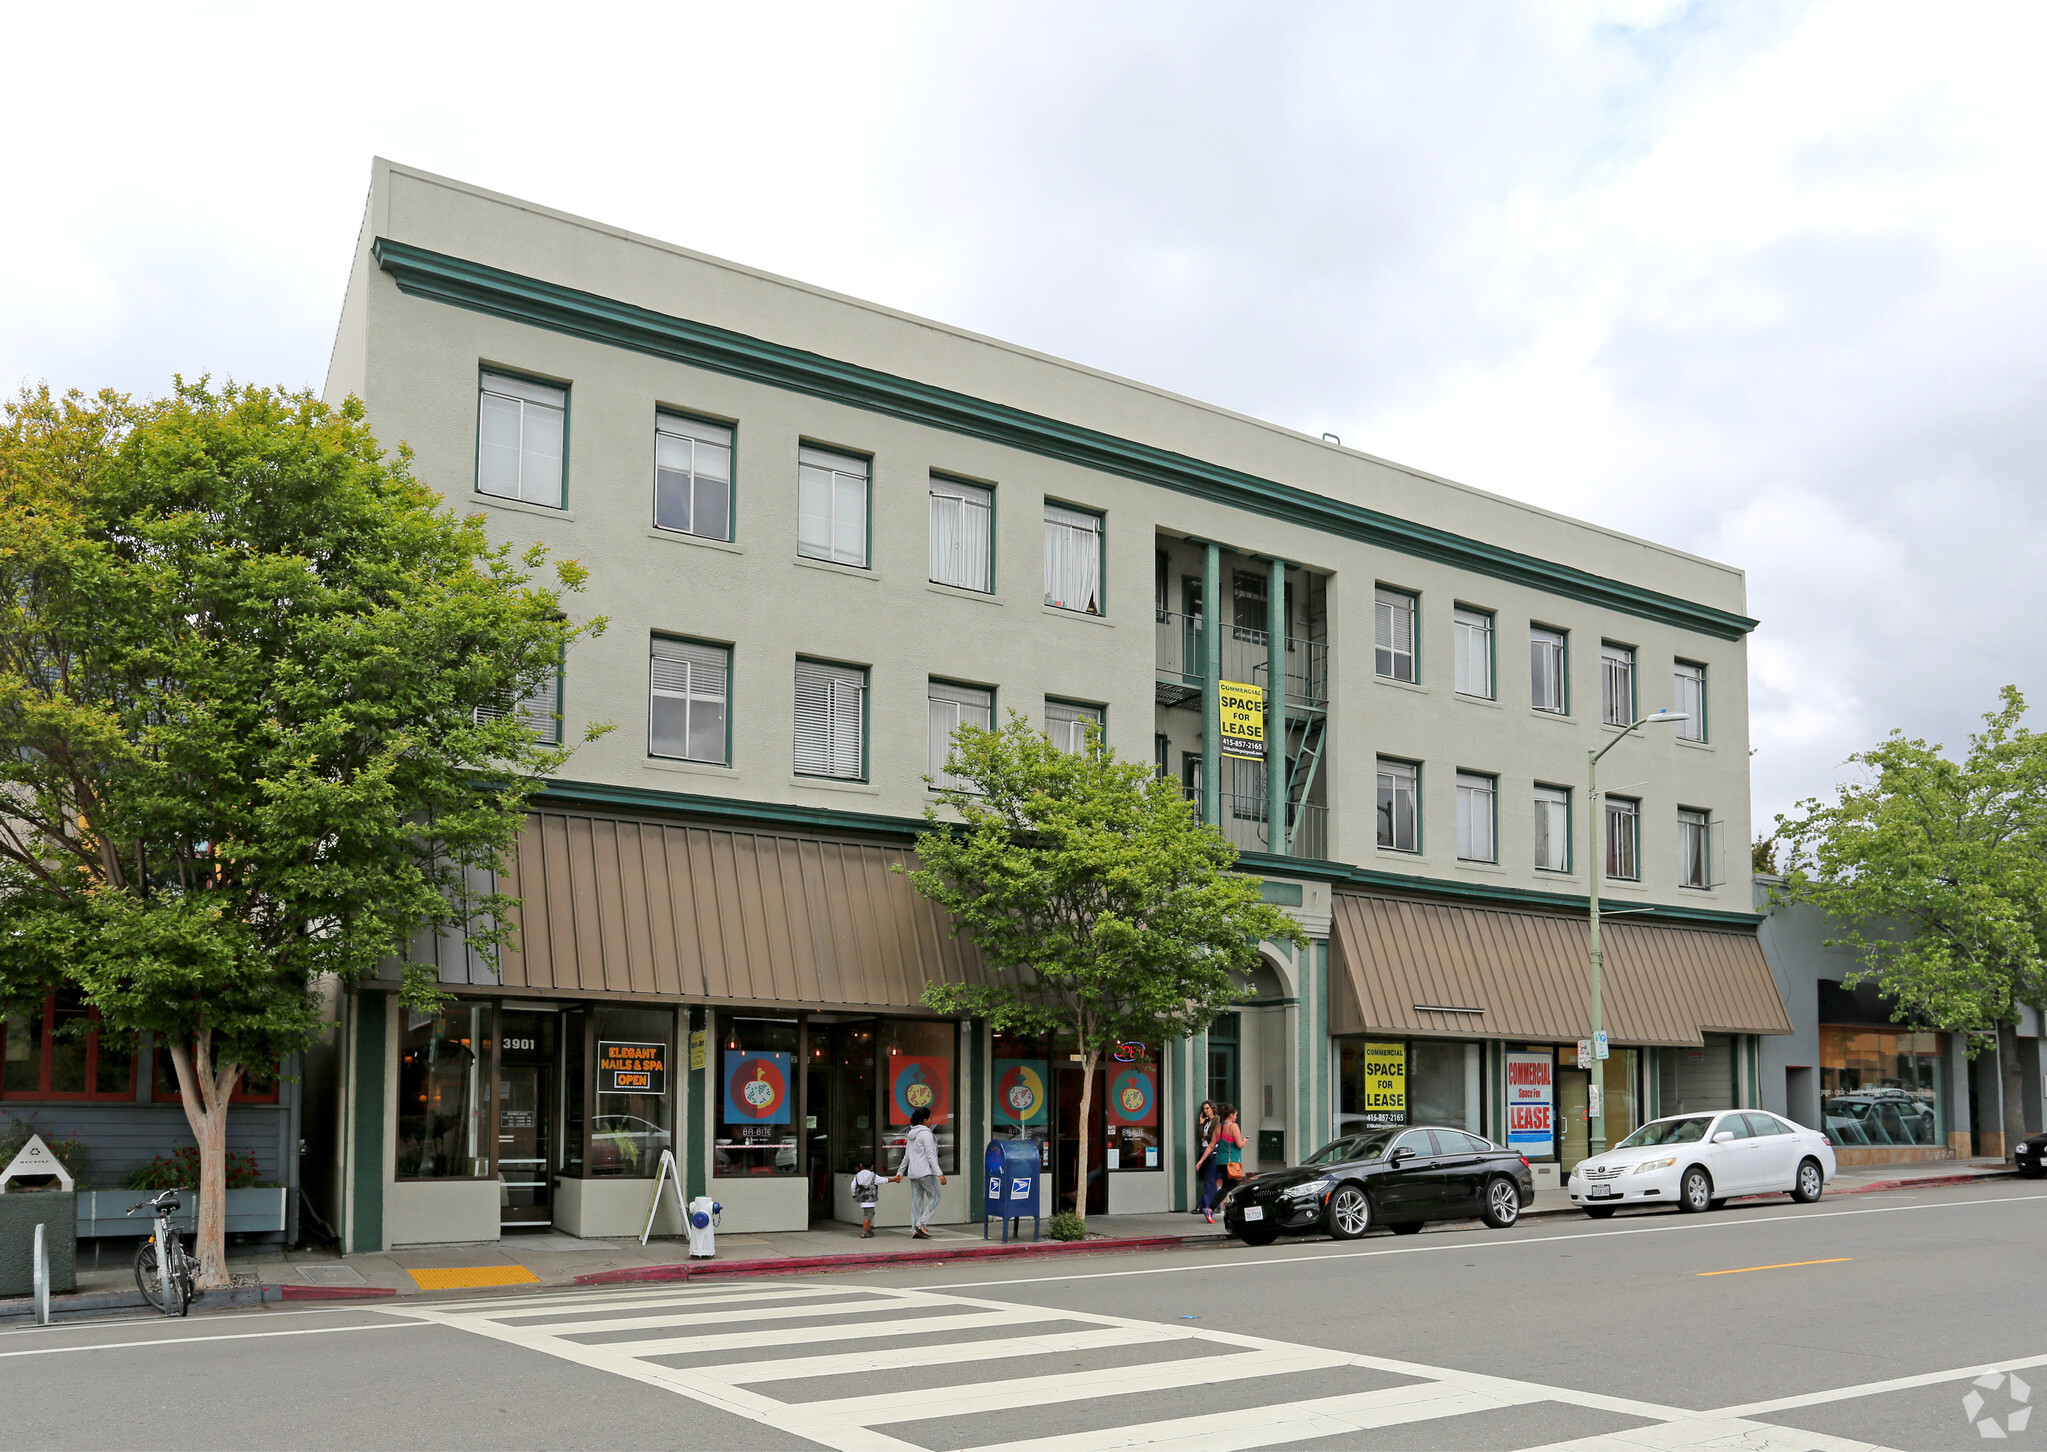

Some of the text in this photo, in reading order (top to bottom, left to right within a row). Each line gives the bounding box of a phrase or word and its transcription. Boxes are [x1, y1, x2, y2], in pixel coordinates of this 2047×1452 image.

[1220, 684, 1261, 696] COMMERCIAL
[1221, 696, 1262, 712] SPACE
[1233, 712, 1250, 721] FOR
[1222, 721, 1262, 738] LEASE
[1222, 738, 1262, 750] 415-857-2165
[503, 1038, 535, 1050] 3901
[608, 1047, 656, 1059] ELEGANT
[1366, 1048, 1403, 1056] COMMERCIAL
[601, 1060, 663, 1071] NAILS & SPA
[1366, 1063, 1404, 1076] SPACE
[1508, 1062, 1551, 1086] COMMERCIAL
[618, 1075, 647, 1086] OPEN
[1377, 1080, 1393, 1089] FOR
[1518, 1088, 1541, 1099] Space For
[1366, 1093, 1404, 1107] LEASE
[1366, 1113, 1404, 1122] 415-857-2165
[1510, 1107, 1551, 1130] LEASE
[742, 1128, 771, 1136] BA-BITE
